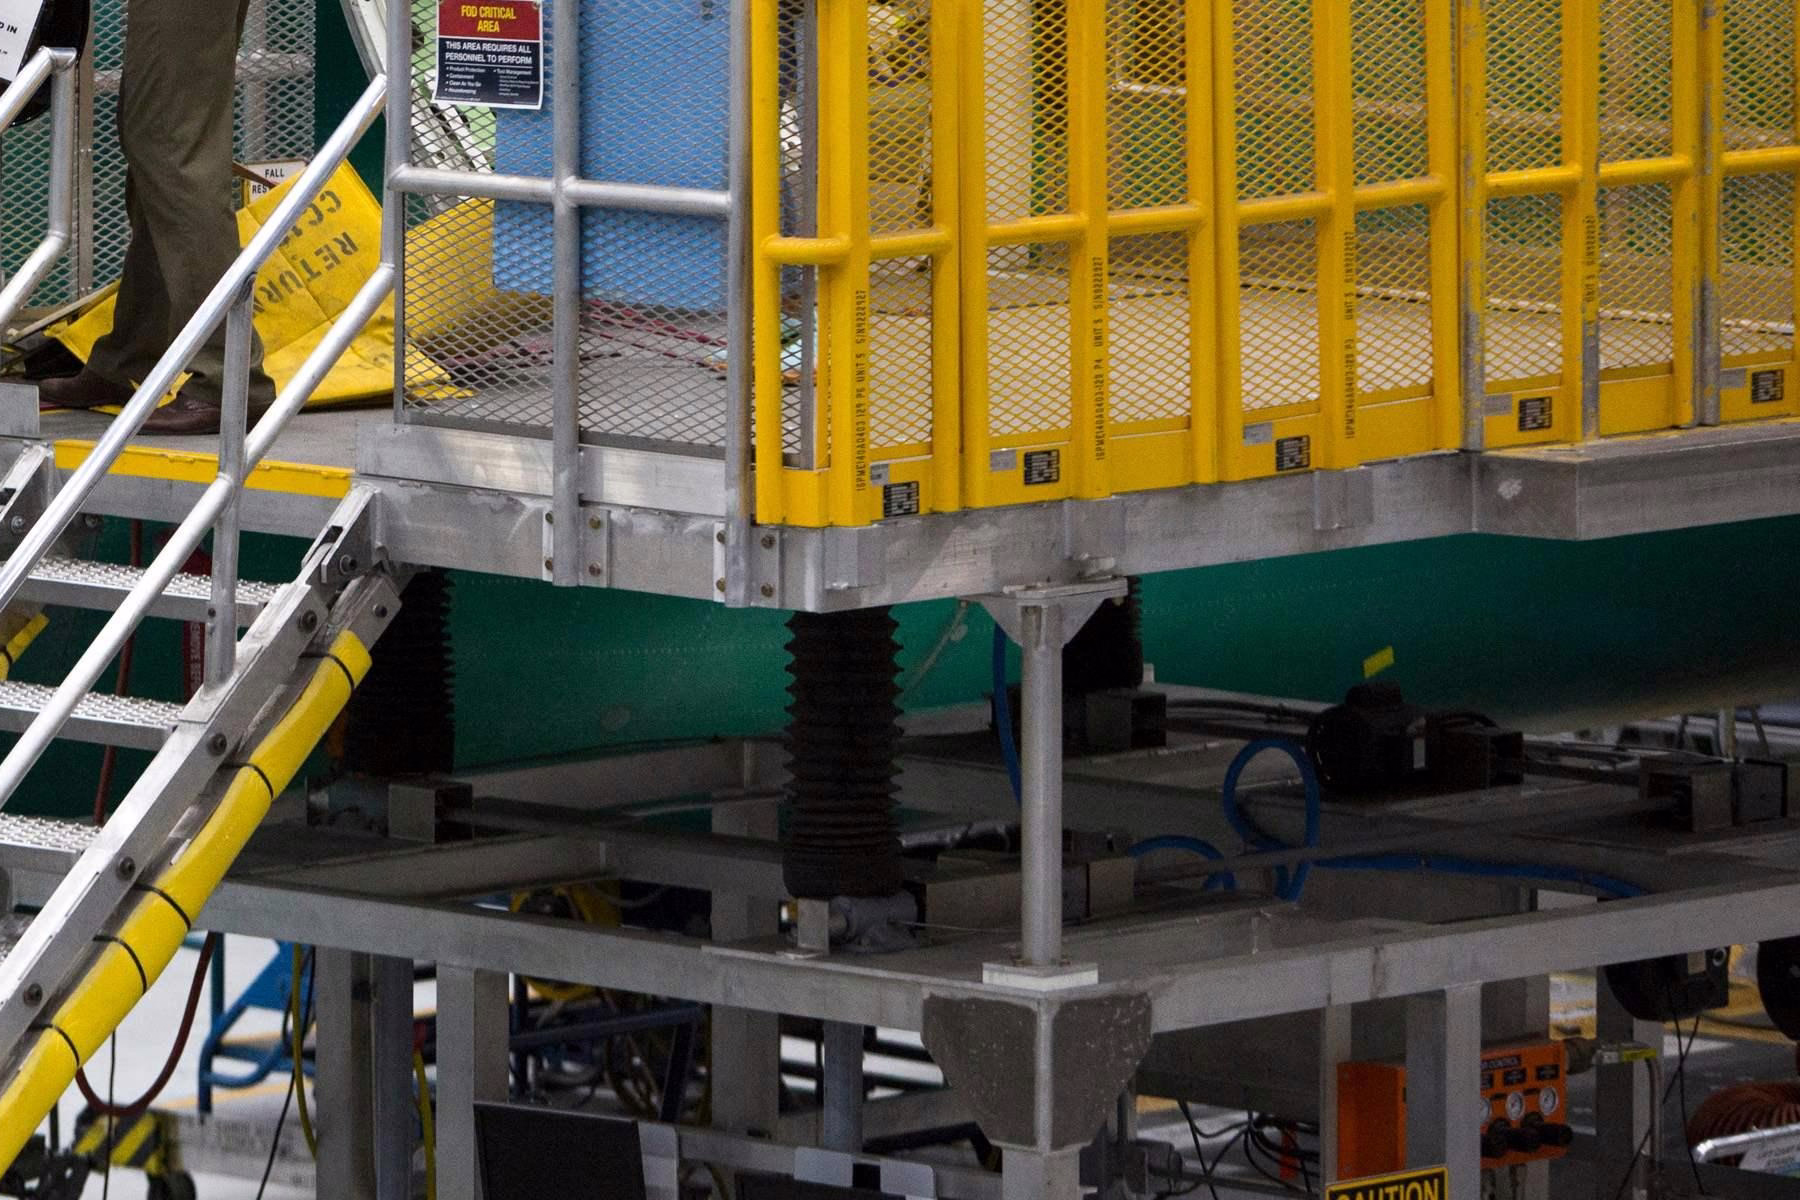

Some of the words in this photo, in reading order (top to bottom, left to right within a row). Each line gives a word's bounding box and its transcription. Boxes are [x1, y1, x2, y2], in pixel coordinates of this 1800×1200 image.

[461, 5, 477, 17] FOD
[479, 6, 516, 19] CRITICAL
[7, 24, 18, 34] IN
[477, 21, 500, 32] AREA
[446, 41, 461, 50] THIS
[462, 42, 481, 51] AREA
[482, 43, 517, 53] REQUIRES
[518, 45, 532, 53] ALL
[445, 53, 485, 62] PERSONNEL
[487, 55, 496, 63] TO
[498, 55, 532, 65] PERFORM
[264, 168, 285, 179] FALL
[1336, 1178, 1439, 1200] TION
